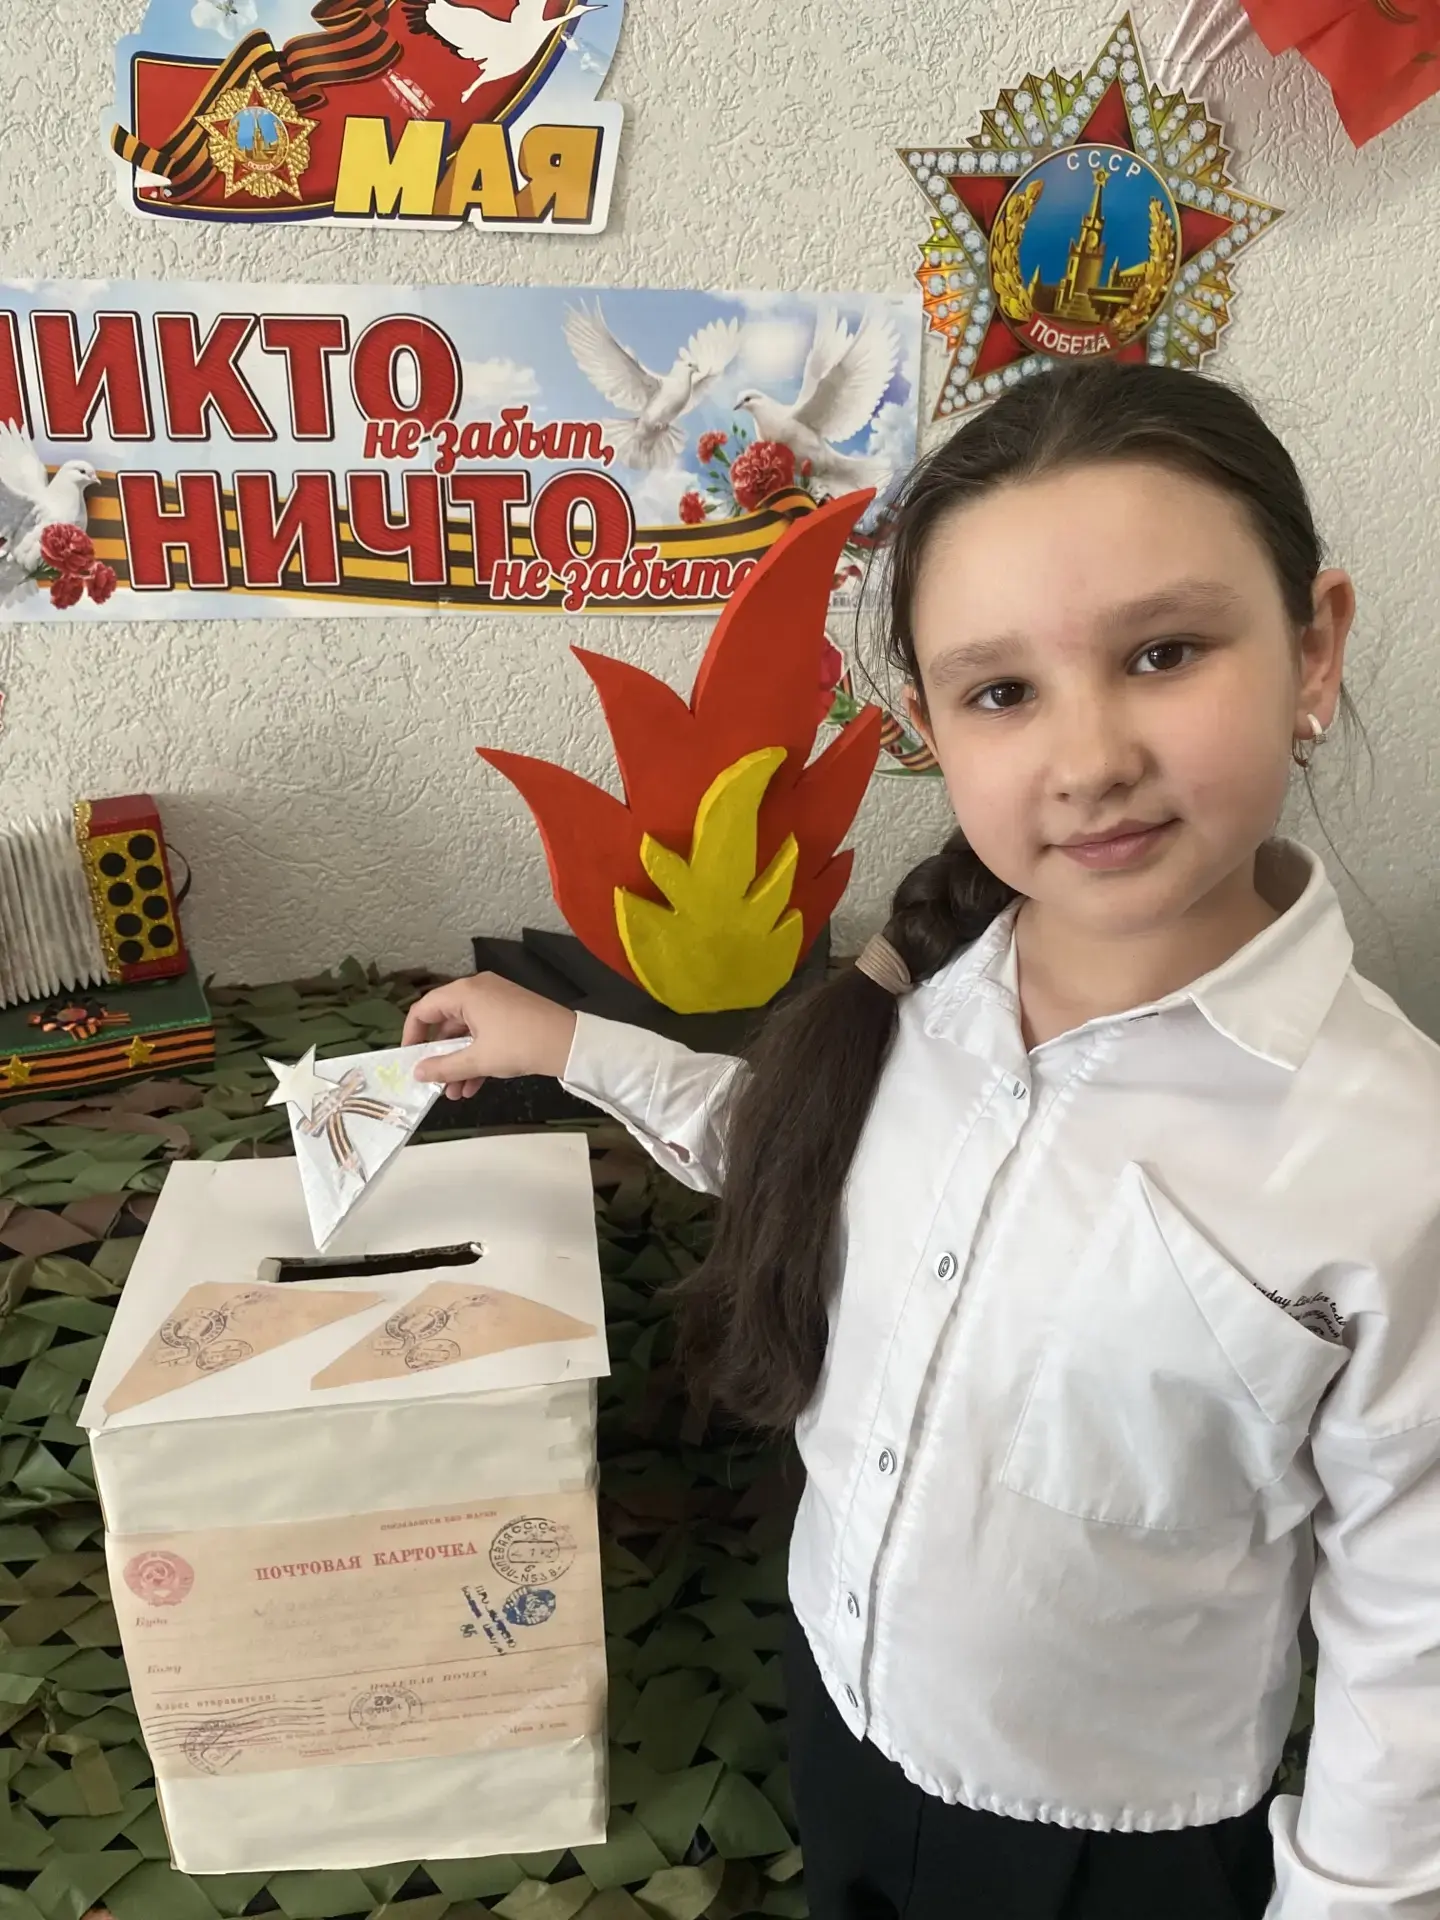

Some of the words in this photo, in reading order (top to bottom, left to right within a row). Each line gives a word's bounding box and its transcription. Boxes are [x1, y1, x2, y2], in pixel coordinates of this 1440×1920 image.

[332, 115, 604, 220] МАЯ
[1066, 150, 1142, 178] СССР
[1029, 319, 1111, 355] ПОБЕДА
[363, 418, 421, 460] не
[431, 404, 615, 475] забыт,
[117, 469, 636, 591] НИЧТО
[490, 558, 549, 600] не
[254, 1555, 362, 1581] ПОЧТОВАЯ
[373, 1541, 479, 1567] КАРТОЧКА
